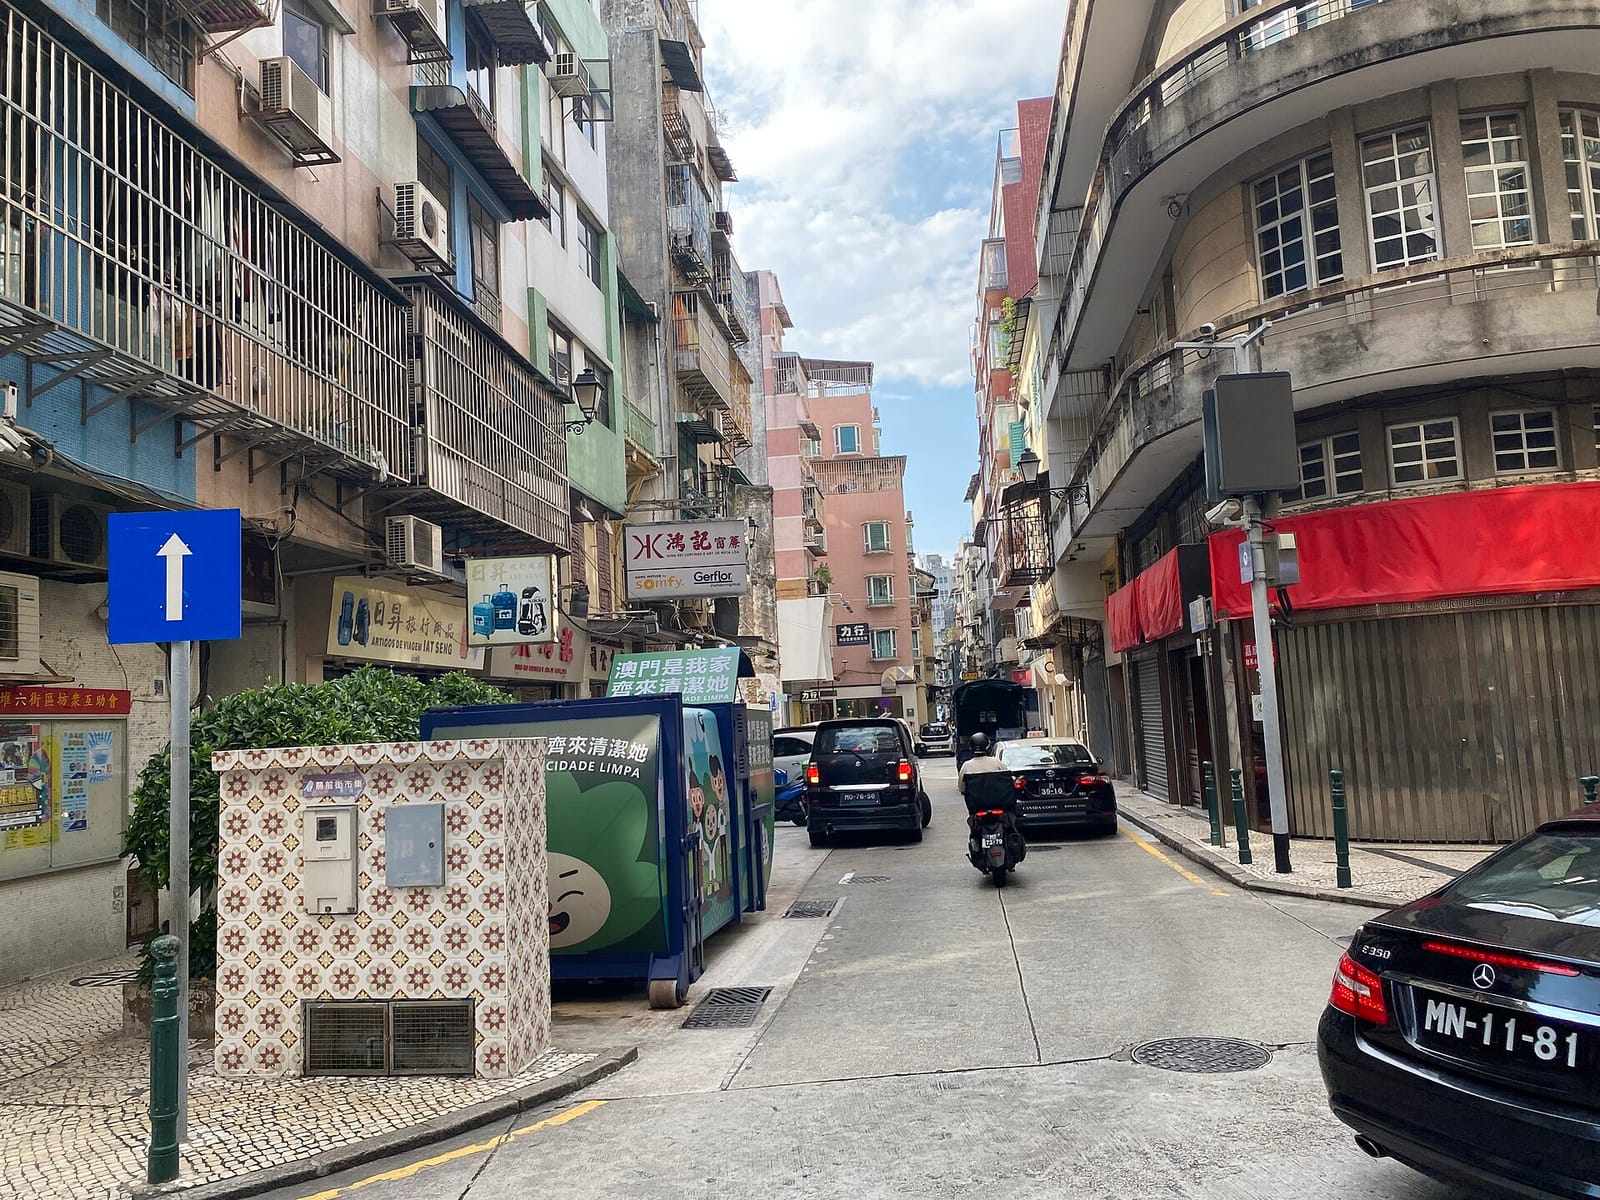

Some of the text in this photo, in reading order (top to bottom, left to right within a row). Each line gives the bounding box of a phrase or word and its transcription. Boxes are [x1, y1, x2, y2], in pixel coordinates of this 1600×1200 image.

[693, 571, 733, 582] Gerflor
[841, 625, 865, 637] 力行
[371, 636, 453, 655] ARTIGOS DE VIAGEM IAT SENG
[614, 655, 732, 679] 澳門是我家
[611, 674, 729, 697] 齊來清潔她
[703, 693, 729, 701] LIMPA
[547, 736, 649, 763] 齊來清潔她
[546, 760, 640, 778] CIDADE LIMPA
[1362, 944, 1391, 960] E350
[1425, 999, 1578, 1068] MN-11-81
